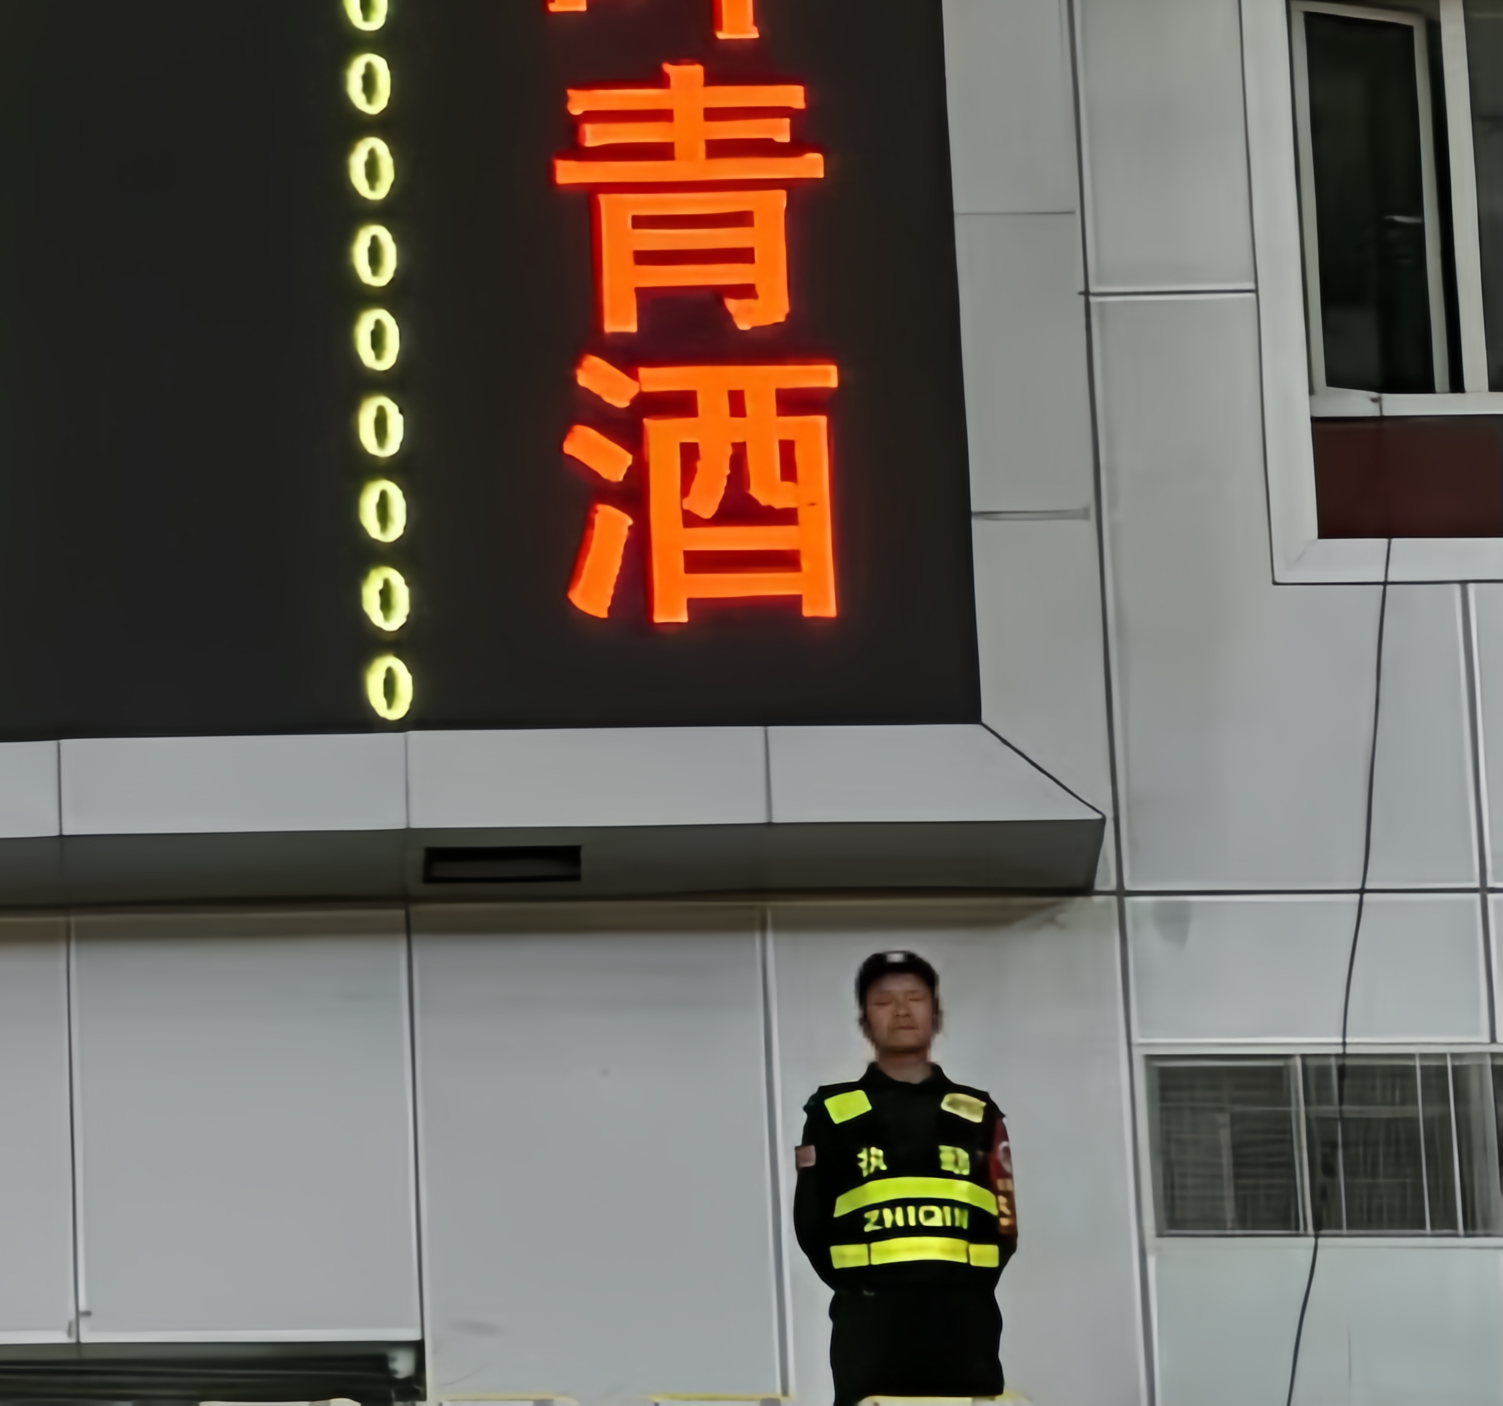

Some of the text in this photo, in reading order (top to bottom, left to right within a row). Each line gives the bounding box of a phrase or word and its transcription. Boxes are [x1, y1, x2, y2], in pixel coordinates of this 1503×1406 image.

[346, 53, 391, 115] 0
[349, 137, 394, 200] 0
[352, 225, 397, 287] 0
[354, 308, 400, 371] 0
[358, 395, 404, 458] 0
[359, 479, 406, 542] 0
[362, 566, 410, 631] 0
[366, 655, 413, 720] 0
